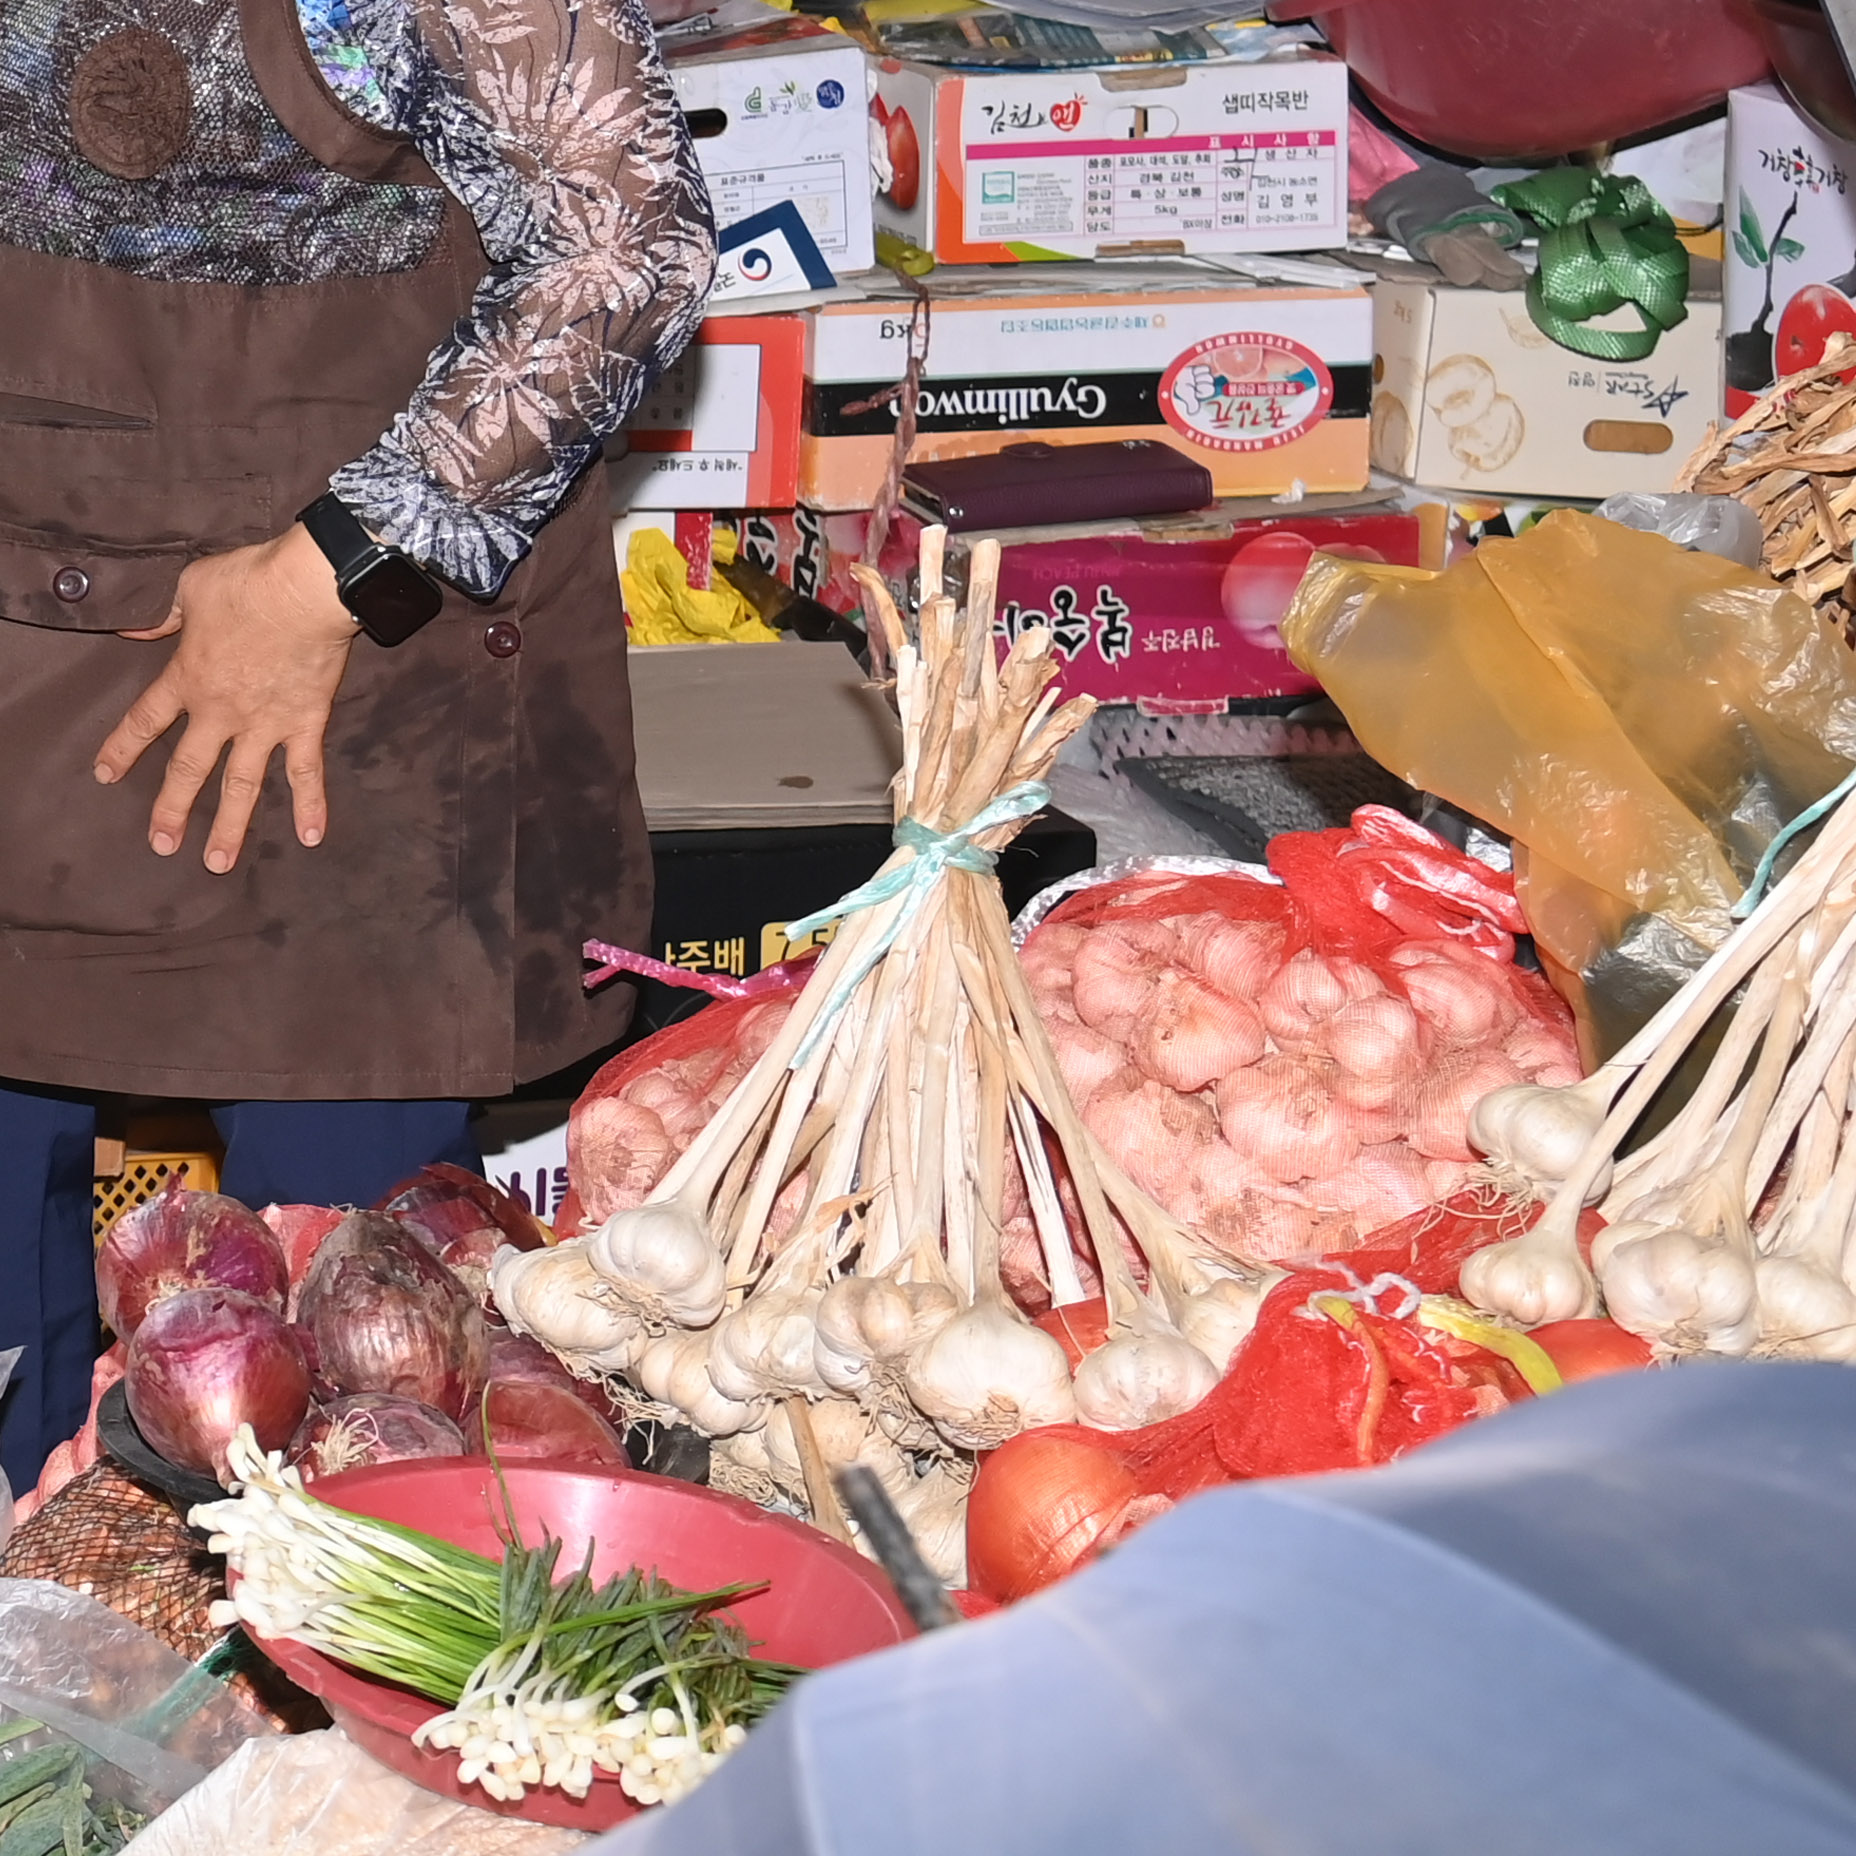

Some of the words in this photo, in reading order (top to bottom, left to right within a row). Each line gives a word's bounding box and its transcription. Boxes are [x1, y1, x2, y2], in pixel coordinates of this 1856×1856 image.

[1088, 173, 1111, 186] 산지
[1139, 172, 1163, 184] 경북
[1170, 171, 1195, 183] 김천
[1088, 190, 1111, 202] 등급
[1154, 187, 1166, 200] 상
[1178, 186, 1202, 199] 보통
[1221, 190, 1245, 203] 성명
[1154, 204, 1178, 216] 5kg
[1221, 213, 1245, 226] 전화
[1141, 625, 1222, 654] 경남진주
[665, 936, 746, 976] 주배
